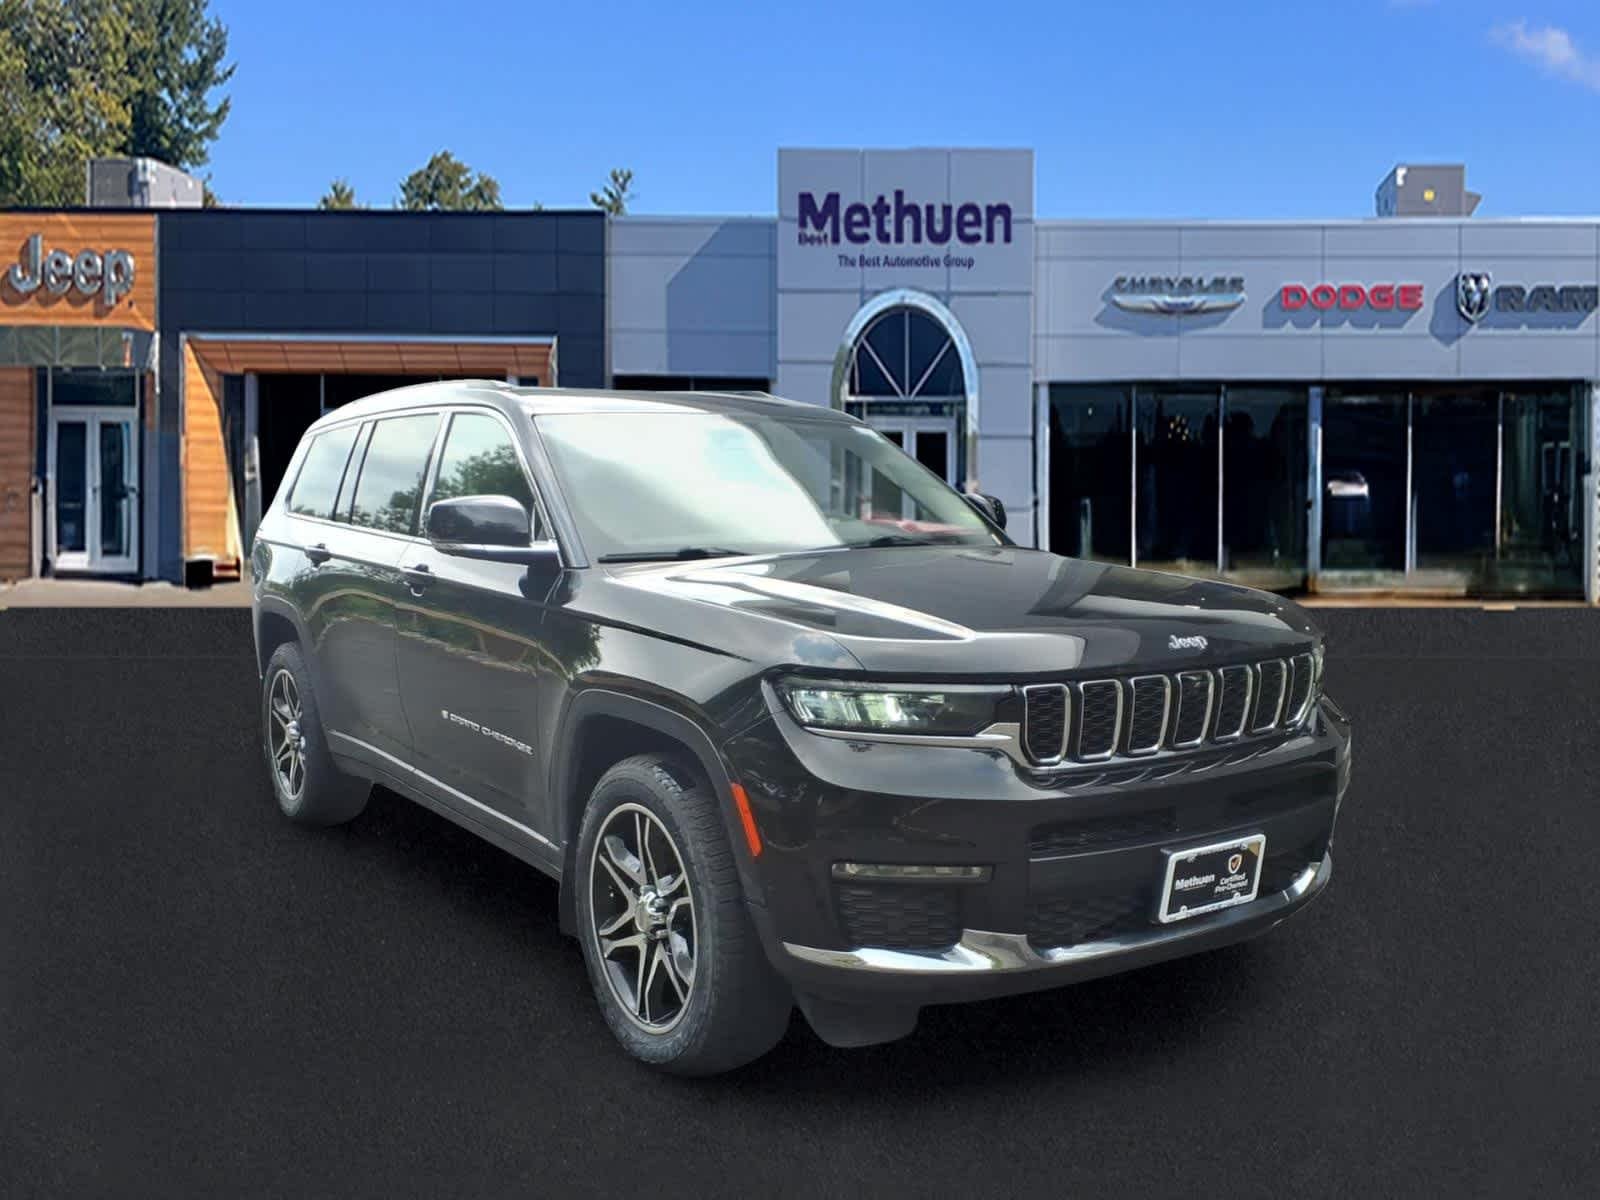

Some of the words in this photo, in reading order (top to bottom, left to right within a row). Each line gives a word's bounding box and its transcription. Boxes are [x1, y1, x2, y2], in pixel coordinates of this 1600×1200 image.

[798, 189, 1012, 244] Methuen
[798, 231, 828, 246] Best
[9, 233, 135, 306] Jeep
[838, 254, 857, 268] The
[858, 254, 881, 268] Best
[882, 254, 941, 268] Automotive
[943, 254, 975, 270] Group
[1113, 275, 1245, 293] CHRYSLER
[1280, 284, 1424, 310] DODGE
[1494, 284, 1599, 312] RAM
[1168, 634, 1208, 651] Jeep
[1175, 874, 1215, 890] Methuen
[1220, 872, 1246, 885] Certified
